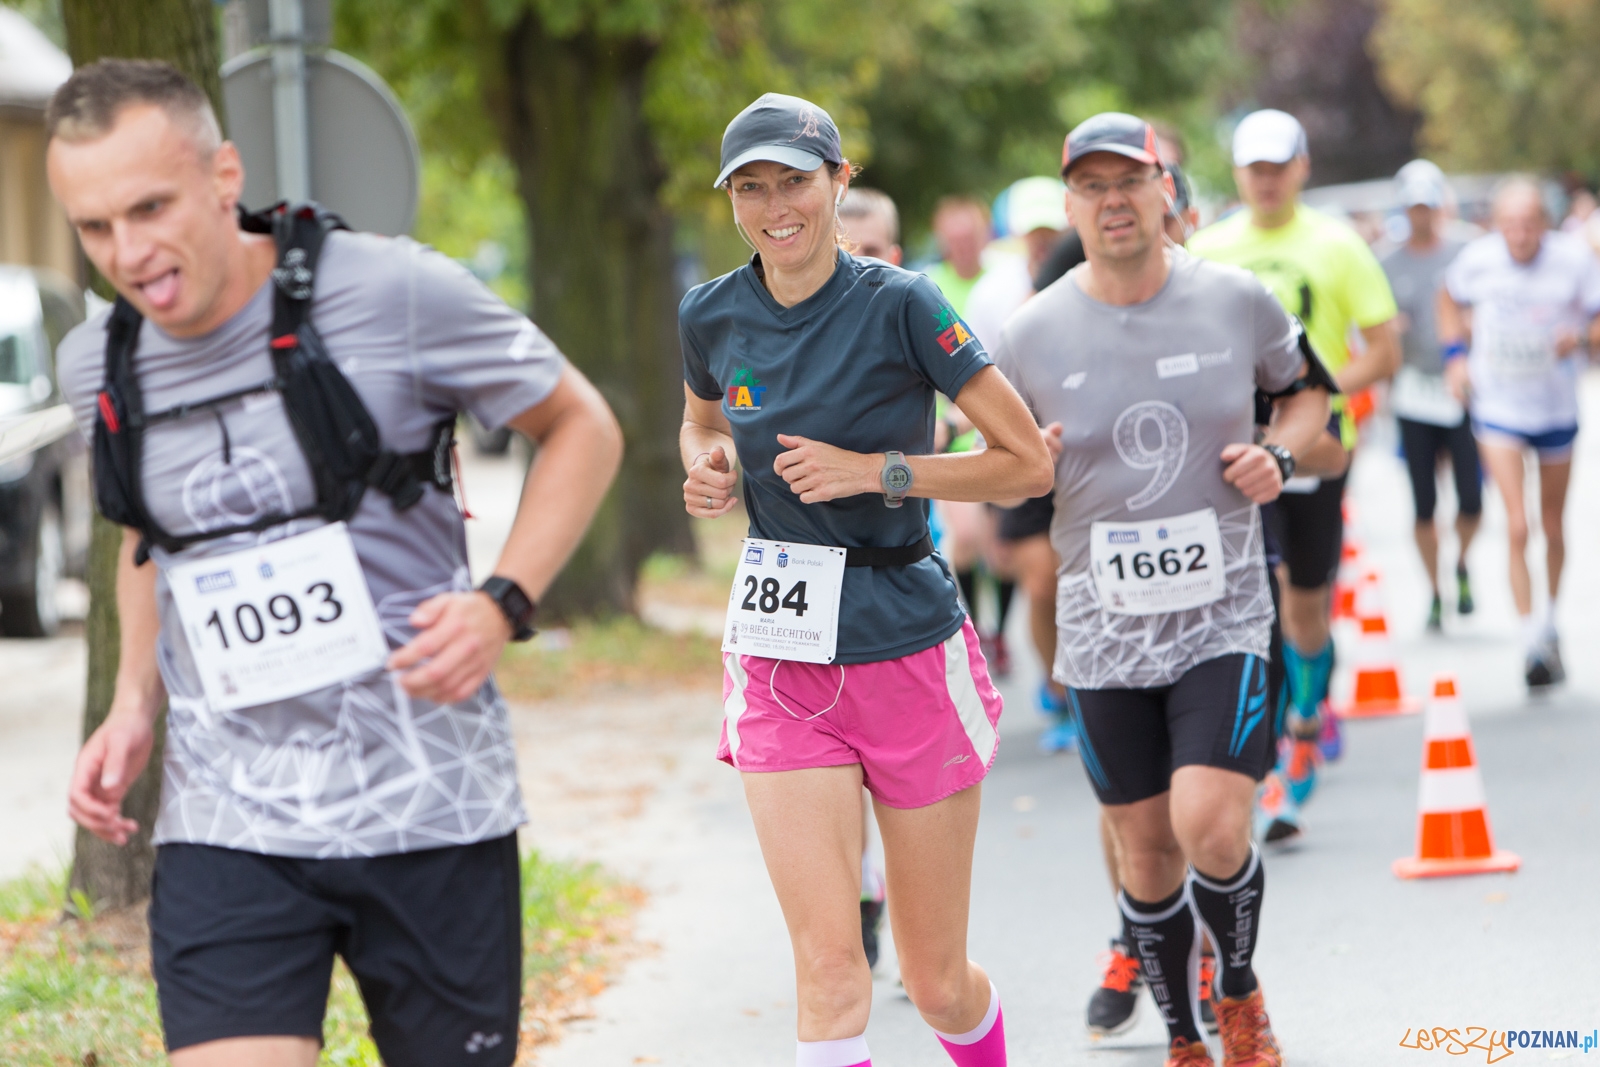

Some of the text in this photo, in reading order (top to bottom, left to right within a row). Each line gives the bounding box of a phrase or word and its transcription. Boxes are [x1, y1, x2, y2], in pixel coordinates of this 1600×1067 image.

[727, 385, 767, 407] FAT
[1112, 400, 1189, 512] 9
[807, 559, 824, 567] Polski
[1108, 543, 1208, 580] 1662
[741, 574, 808, 617] 284
[206, 582, 342, 649] 1093
[749, 624, 769, 636] BIEG
[771, 627, 822, 641] LECHITÓW
